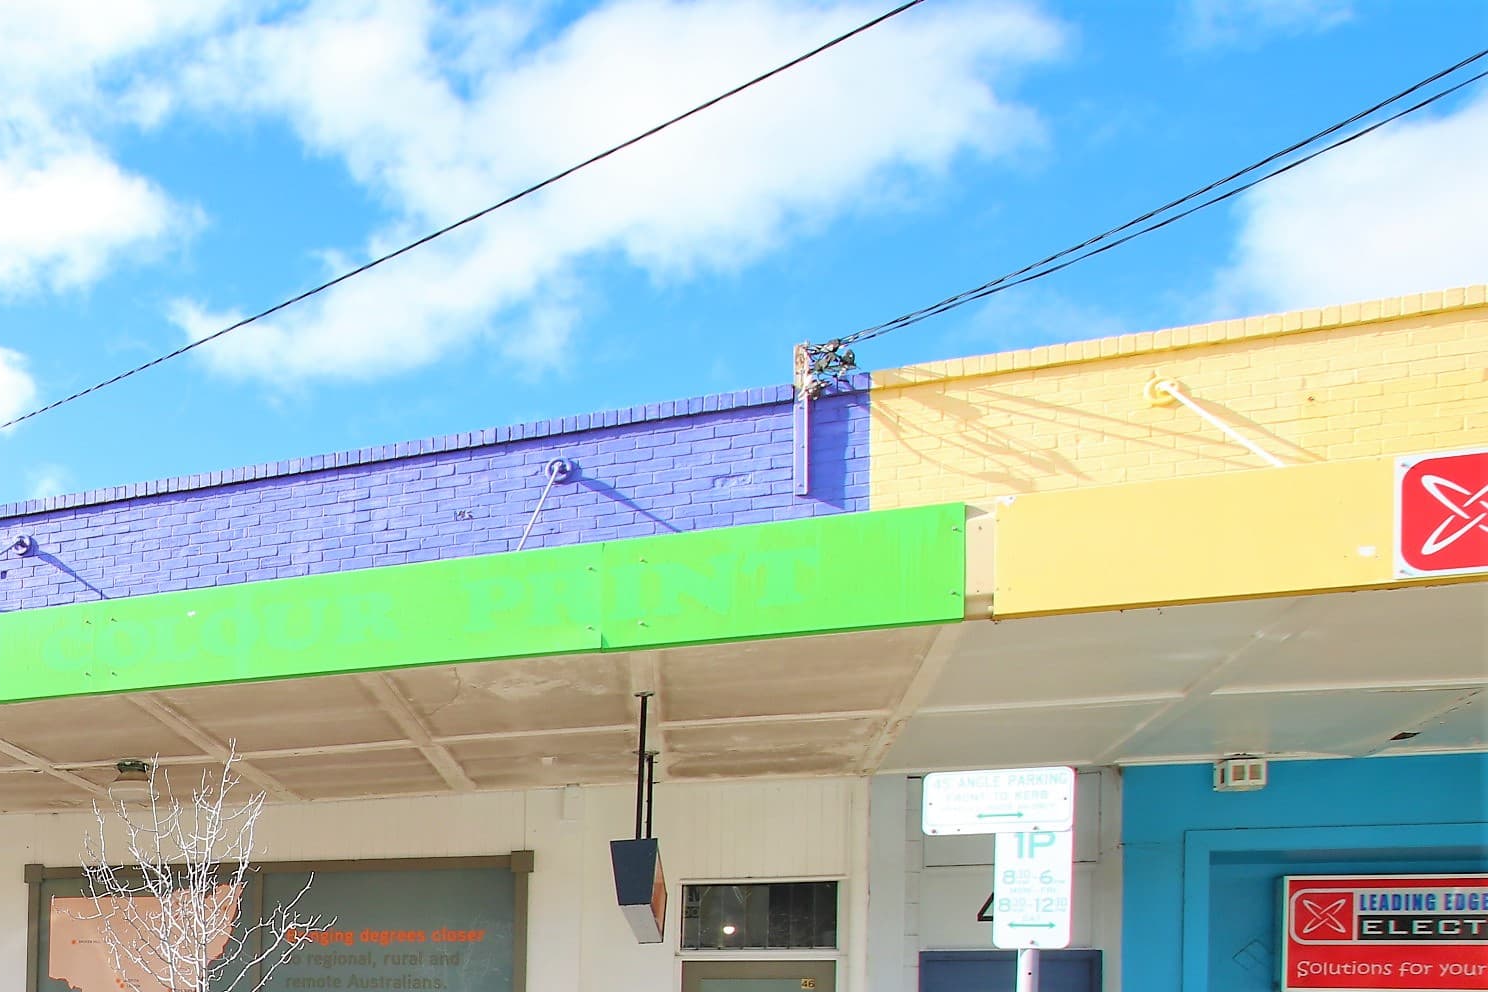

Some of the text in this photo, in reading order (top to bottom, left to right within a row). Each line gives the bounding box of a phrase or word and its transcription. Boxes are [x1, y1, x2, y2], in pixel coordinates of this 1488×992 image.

[41, 591, 402, 673] COLOUR
[463, 544, 820, 632] PRINT
[1008, 772, 1068, 785] PARKING
[1014, 831, 1057, 859] 1P
[1359, 893, 1438, 911] LEADING
[359, 927, 426, 947] degrees
[431, 926, 486, 943] closer
[307, 951, 376, 968] regional,
[383, 951, 423, 966] rural
[430, 951, 461, 966] and
[1297, 960, 1393, 977] Solutions
[1399, 961, 1433, 976] for
[286, 974, 448, 990] remote Australians.
[802, 979, 816, 988] 46
